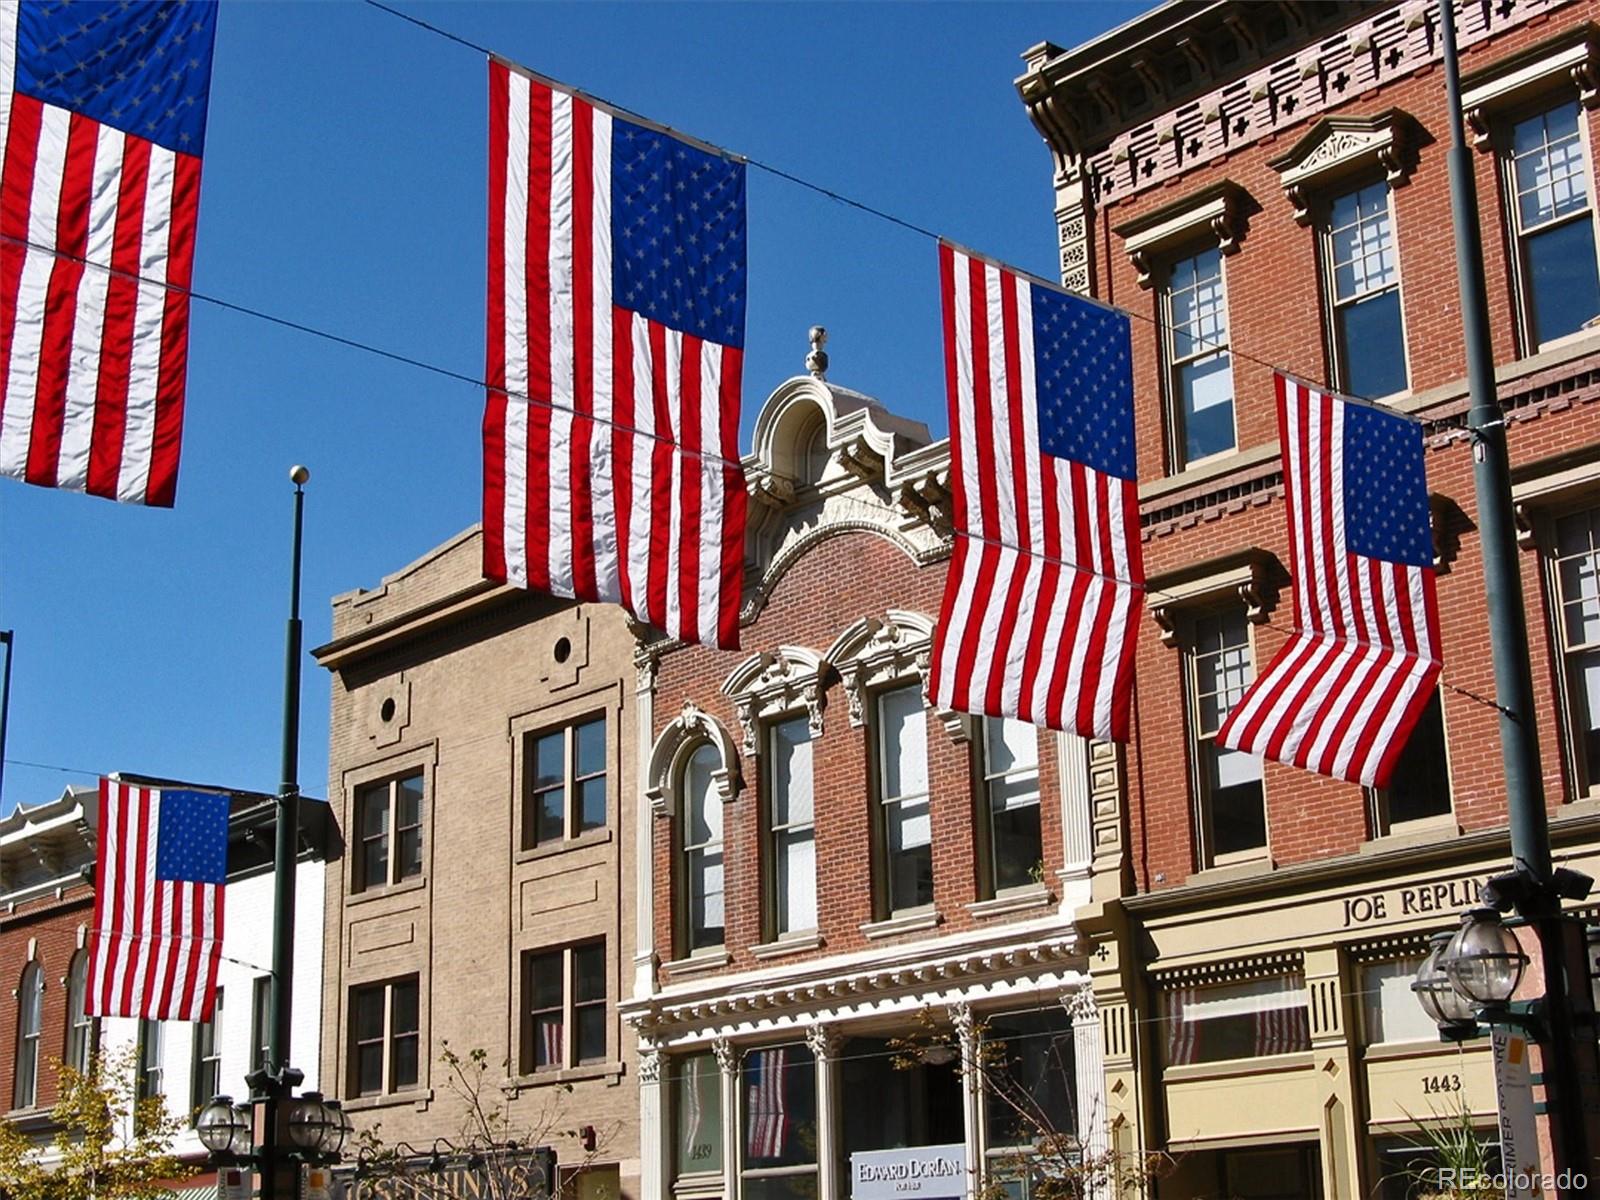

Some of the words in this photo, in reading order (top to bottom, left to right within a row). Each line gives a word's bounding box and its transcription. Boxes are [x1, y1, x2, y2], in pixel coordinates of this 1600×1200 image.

[1343, 894, 1387, 928] JOE
[1421, 1074, 1462, 1095] 1443
[858, 1162, 909, 1183] EDWARD
